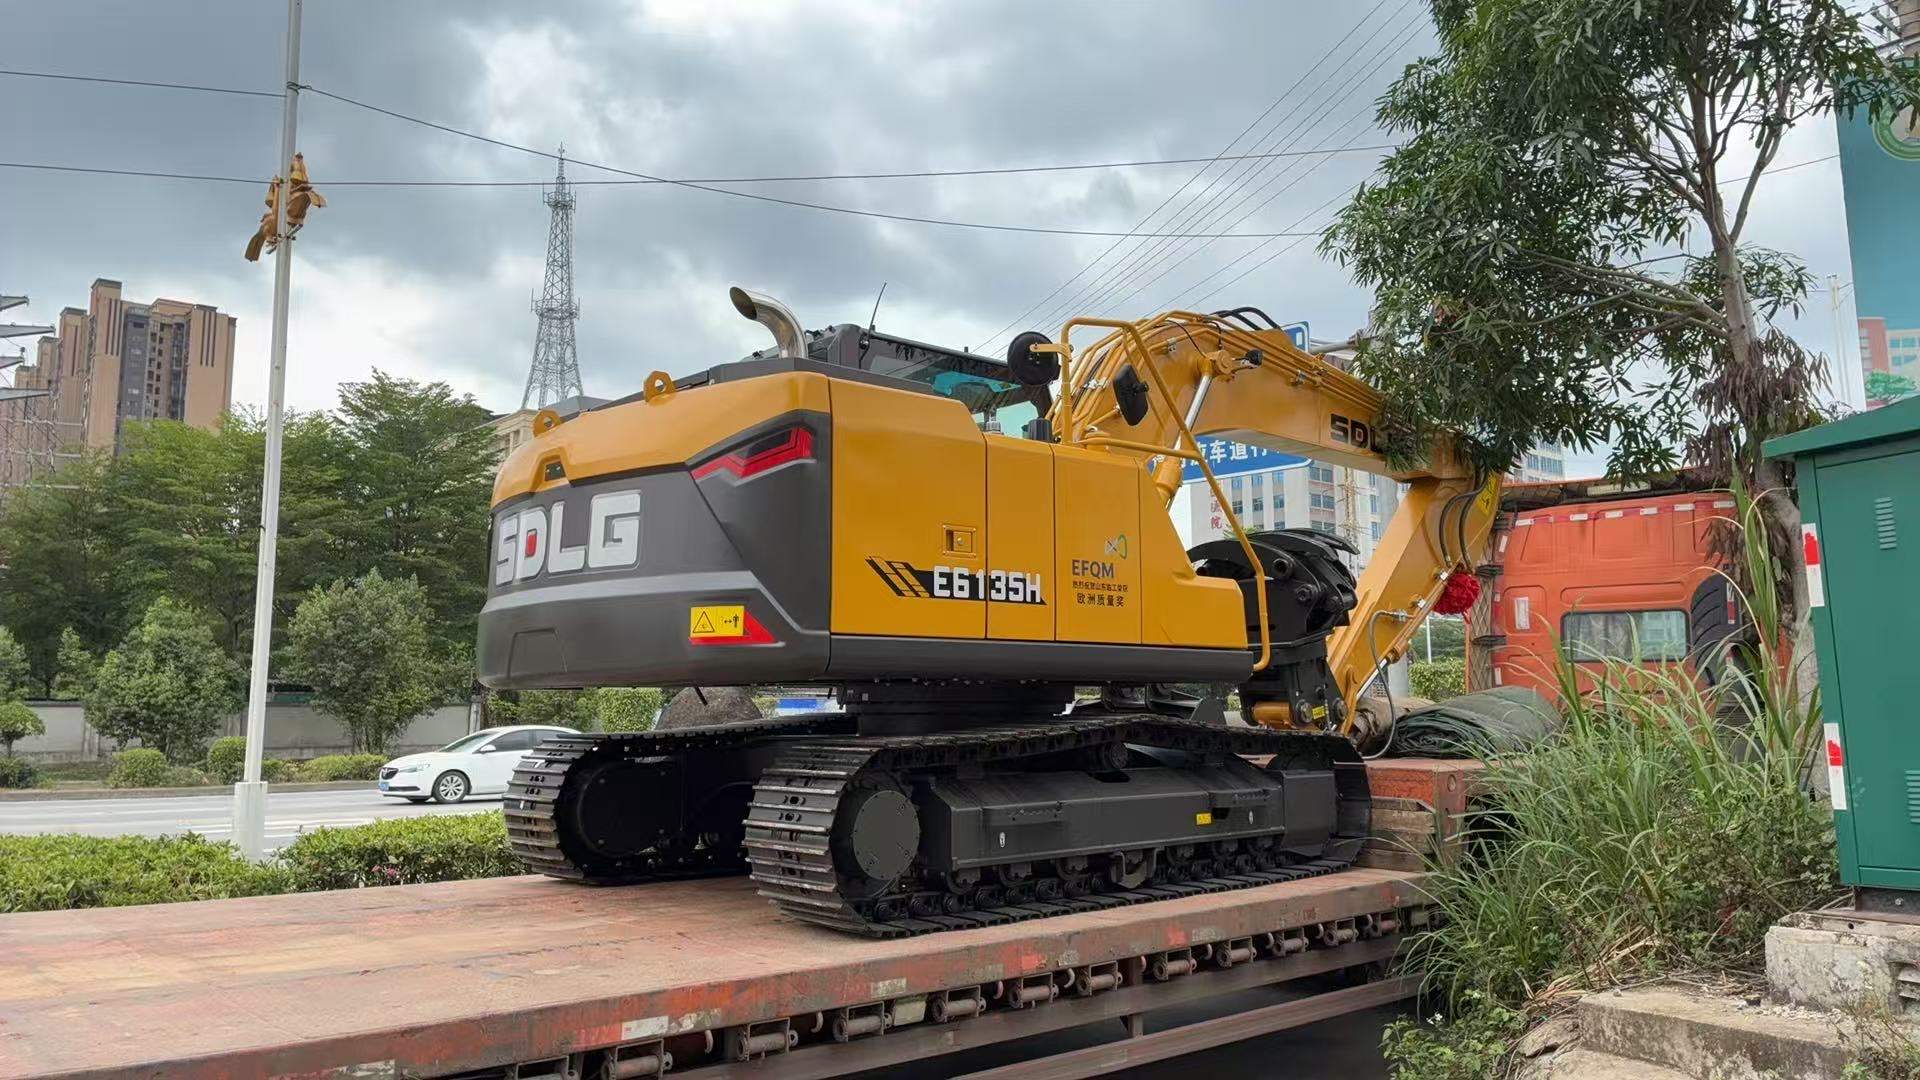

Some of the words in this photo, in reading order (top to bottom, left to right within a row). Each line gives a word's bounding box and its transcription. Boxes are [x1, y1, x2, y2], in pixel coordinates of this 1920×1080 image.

[496, 489, 641, 586] SDLG
[1072, 559, 1114, 579] EFQM
[933, 565, 1041, 603] E6135H
[1077, 592, 1125, 607] 欧洲质量奖
